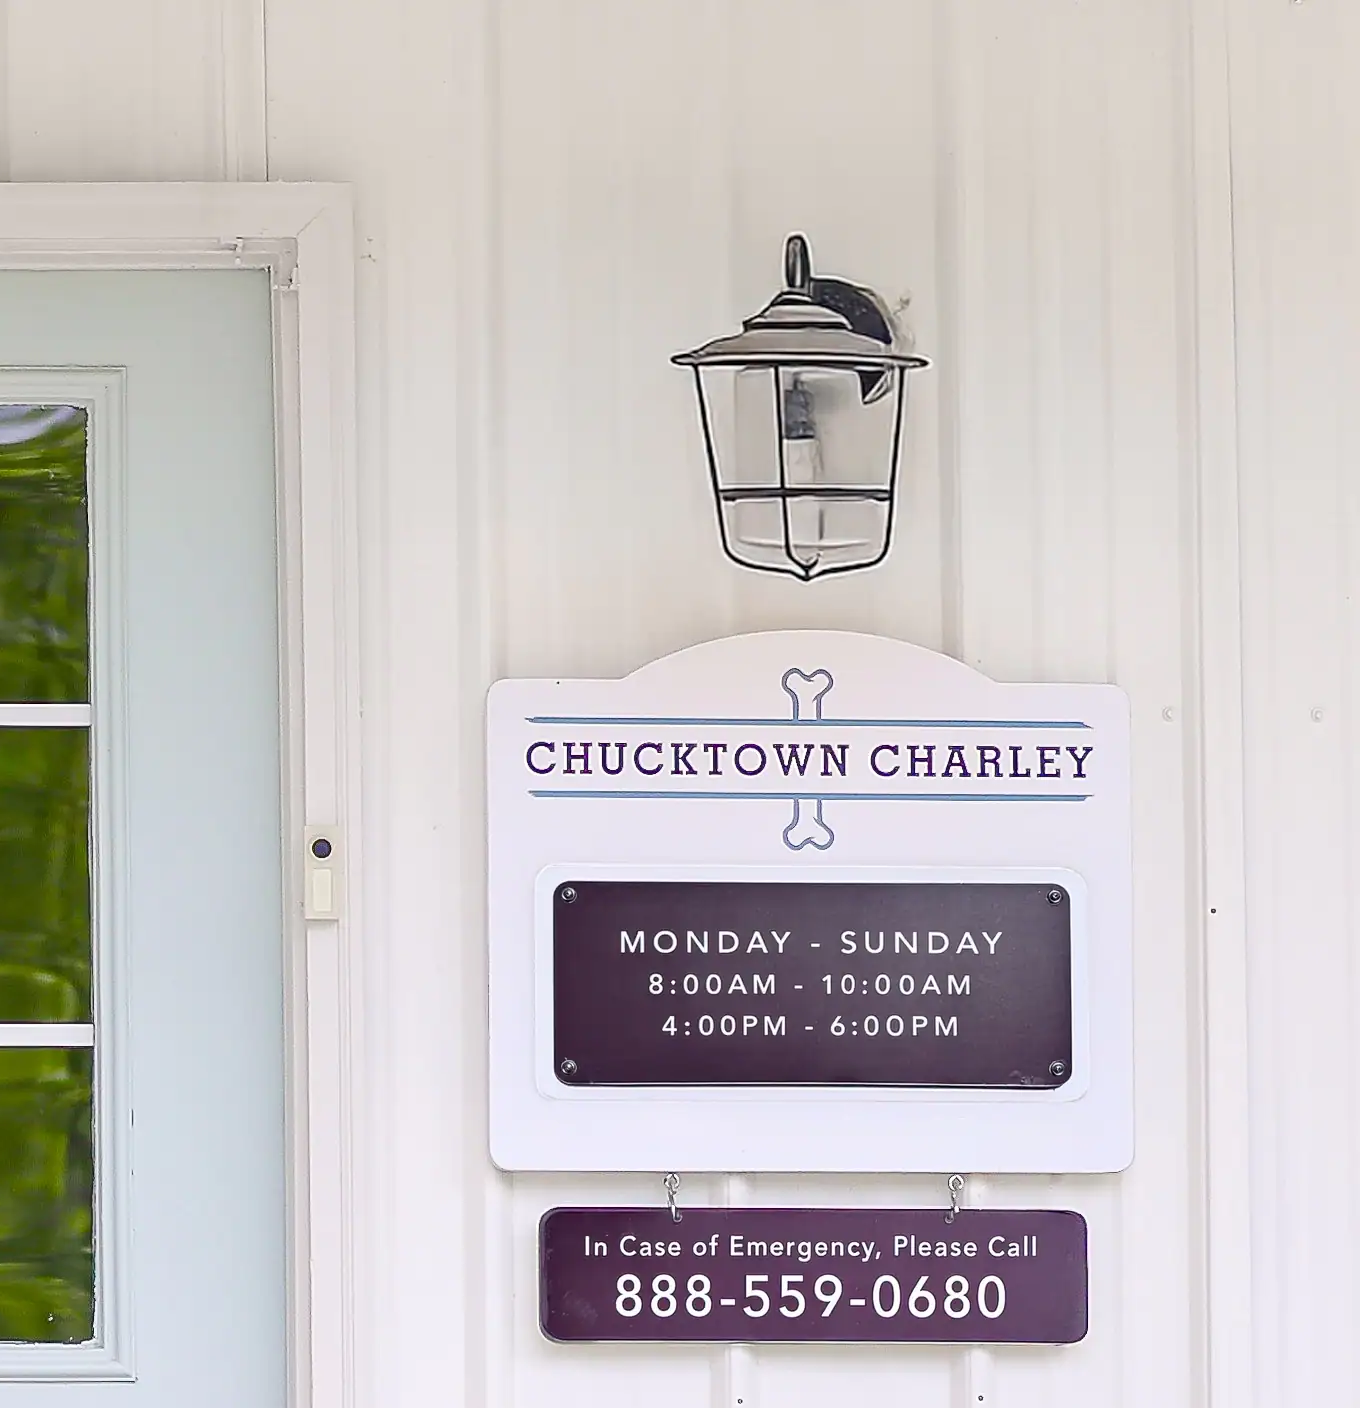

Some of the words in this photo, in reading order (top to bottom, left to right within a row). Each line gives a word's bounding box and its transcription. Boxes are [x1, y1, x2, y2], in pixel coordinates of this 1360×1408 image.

[526, 741, 850, 777] CHUCKTOWN
[870, 744, 1094, 779] CHARLEY
[620, 930, 791, 955] MONDAY
[840, 930, 1003, 955] SUNDAY
[648, 973, 777, 996] 8:00AM
[821, 973, 972, 996] 10:00AM
[661, 1014, 787, 1037] 4:00PM
[830, 1014, 959, 1037] 6:00PM
[583, 1234, 608, 1257] In
[619, 1234, 682, 1257] Case
[692, 1233, 720, 1257] of
[729, 1234, 882, 1263] Emergency,
[893, 1233, 978, 1257] Please
[988, 1234, 1038, 1257] Call
[615, 1273, 1006, 1319] 888-559-0680
